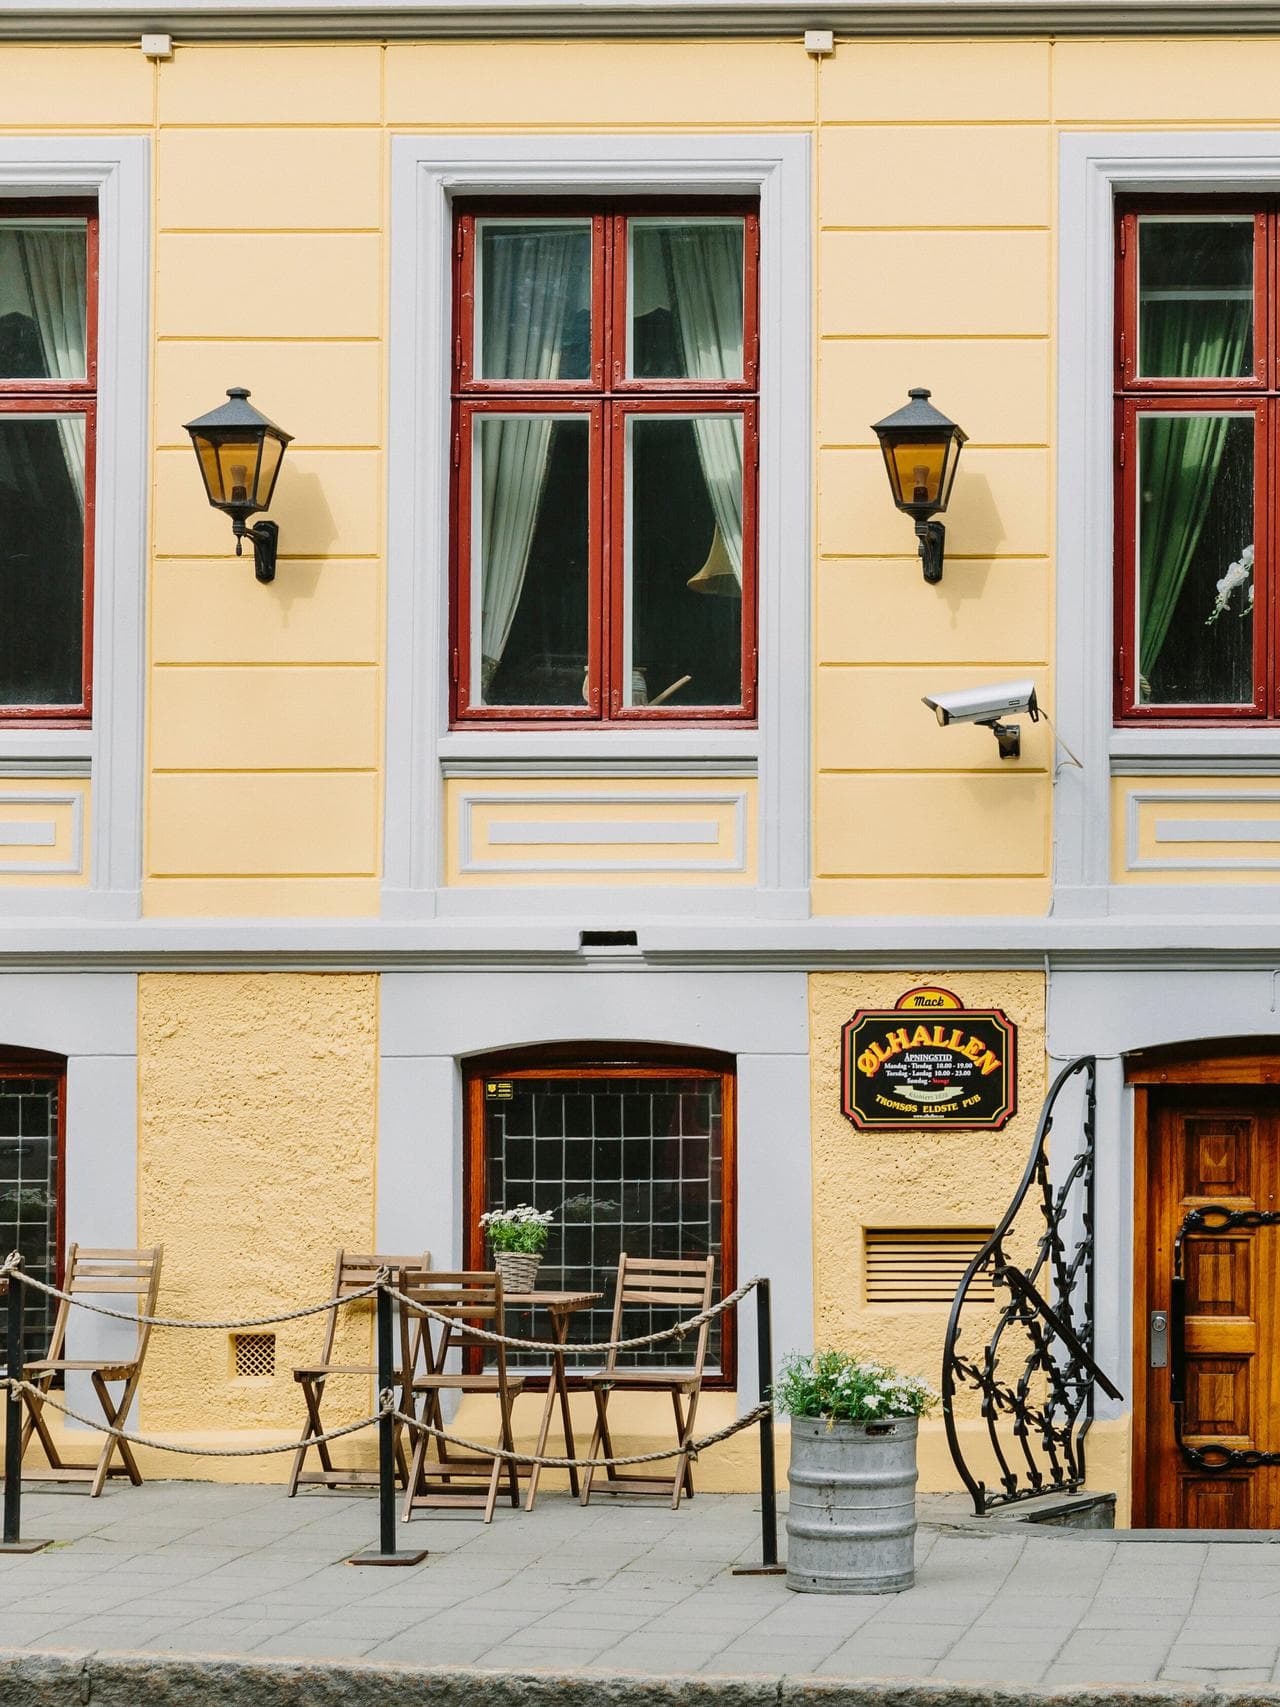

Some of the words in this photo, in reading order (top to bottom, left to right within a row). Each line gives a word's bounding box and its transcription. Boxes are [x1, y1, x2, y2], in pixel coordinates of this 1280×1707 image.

[914, 996, 944, 1007] Mack
[857, 1024, 1002, 1078] ØLHALLEN
[904, 1052, 952, 1062] ÅPNINGSTID
[884, 1062, 907, 1070] Mandag
[886, 1070, 908, 1078] Torsdag
[875, 1094, 917, 1112] TROMSØS
[923, 1103, 958, 1113] ELDSTE
[962, 1094, 981, 1108] PUB
